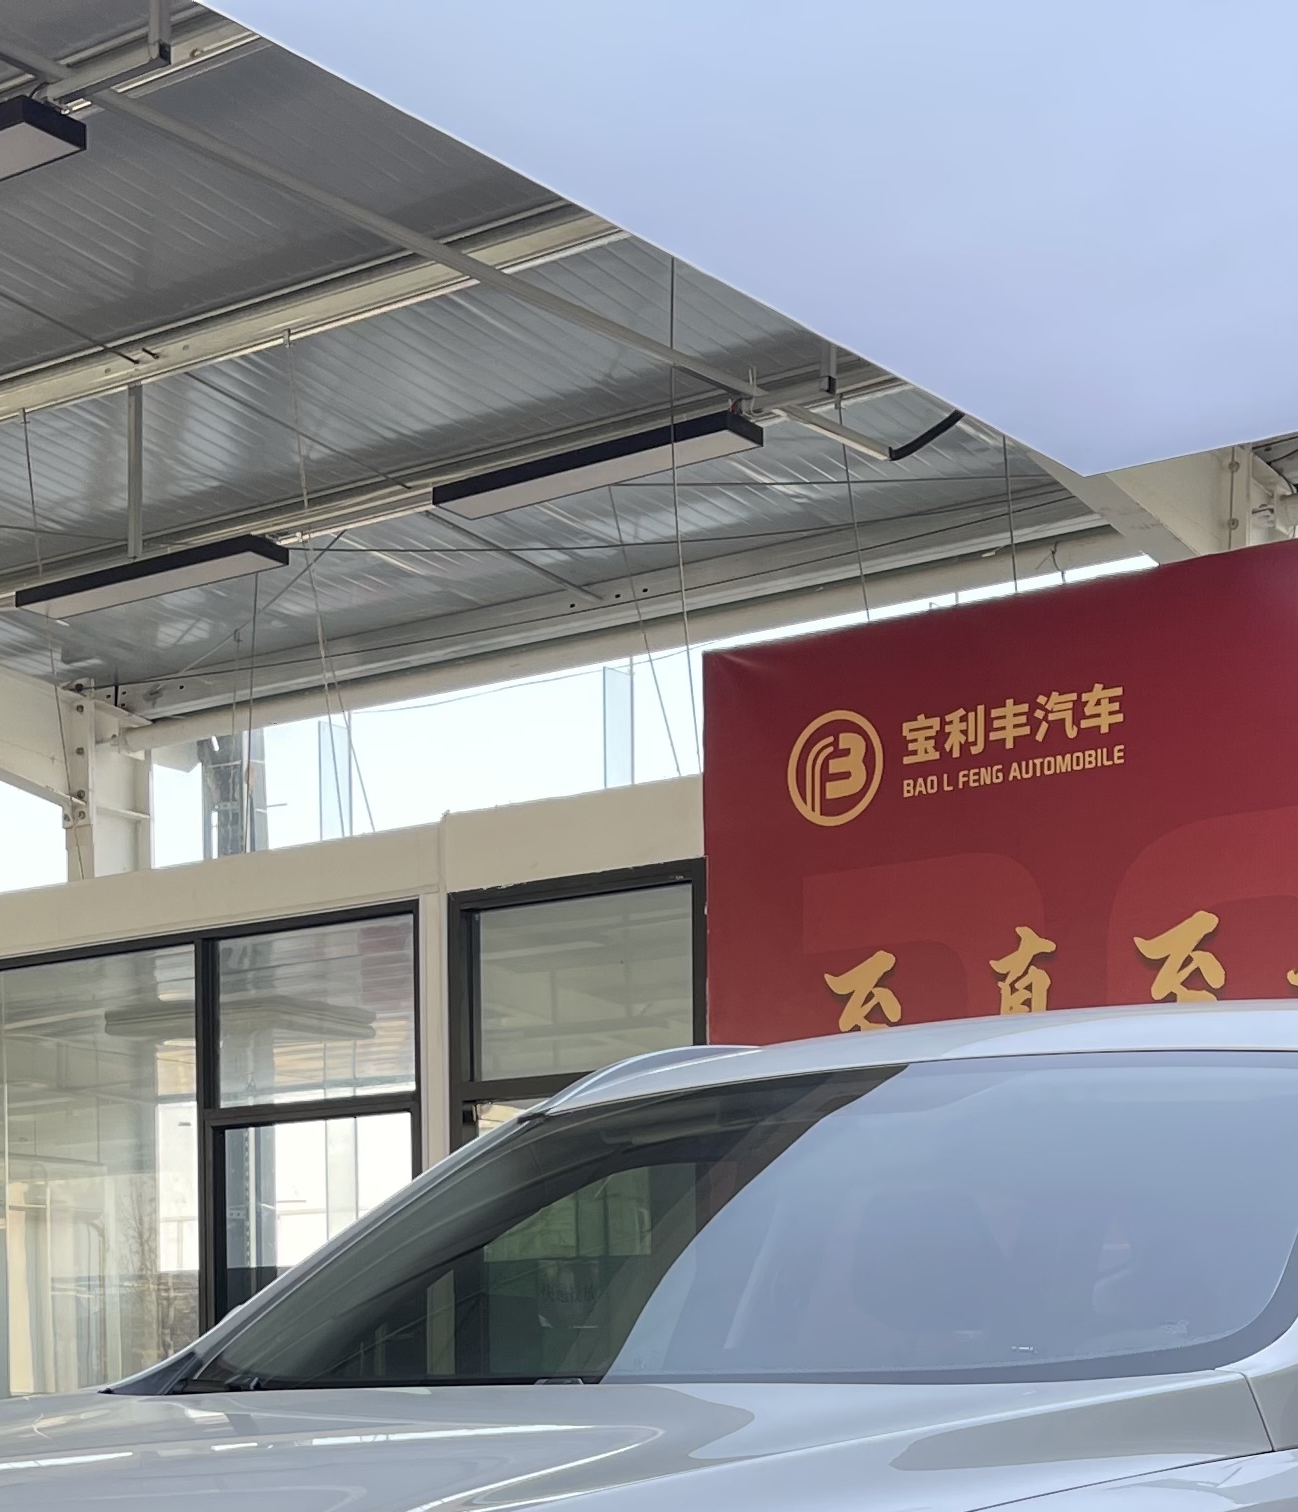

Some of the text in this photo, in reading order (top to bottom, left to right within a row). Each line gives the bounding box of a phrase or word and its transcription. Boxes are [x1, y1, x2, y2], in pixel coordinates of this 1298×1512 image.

[902, 683, 1124, 765] 宝利丰汽车
[902, 775, 938, 798] BAO
[958, 765, 1004, 789] FENG
[1008, 745, 1125, 782] AUTOMOBILE
